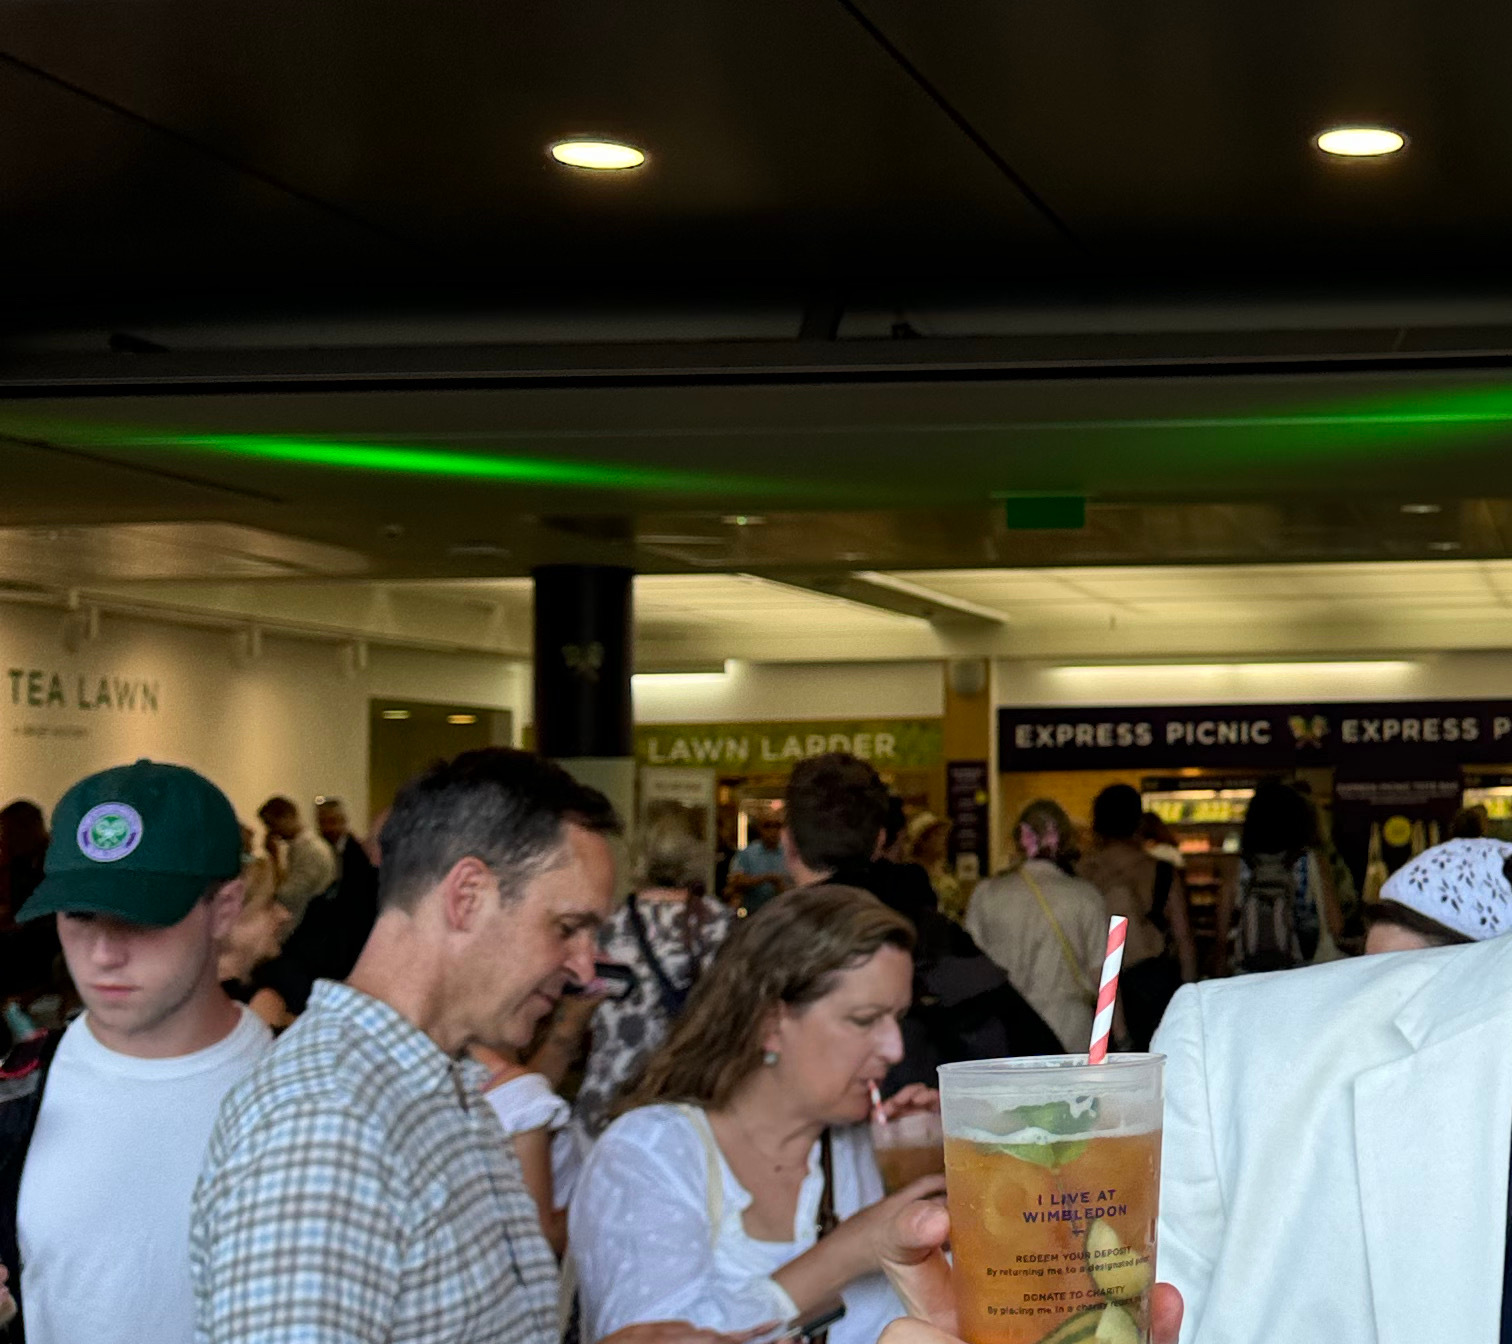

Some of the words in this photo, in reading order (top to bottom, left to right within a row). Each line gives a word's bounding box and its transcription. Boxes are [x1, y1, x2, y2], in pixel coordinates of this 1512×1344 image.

[8, 667, 66, 706] TEA
[77, 674, 158, 712] LAWN
[1015, 722, 1153, 749] EXPRESS
[1166, 720, 1272, 746] PICNIC
[1341, 717, 1480, 743] EXPRESS
[648, 736, 749, 762] LAWN
[760, 732, 897, 761] LARDER
[1038, 1194, 1043, 1206] I
[1051, 1191, 1090, 1205] LIVE
[1097, 1189, 1117, 1201] AT
[1023, 1205, 1127, 1223] WIMBLEDON
[1016, 1253, 1059, 1263] REDEEM
[1062, 1251, 1091, 1261] YOUR
[1094, 1245, 1132, 1259] DEPOSIT
[986, 1267, 997, 1277] By
[1000, 1268, 1044, 1277] returning
[1047, 1267, 1063, 1275] me
[1023, 1292, 1066, 1302] DONATE
[1070, 1290, 1083, 1299] TO
[1087, 1285, 1126, 1297] CHARITY
[987, 1306, 998, 1315] By
